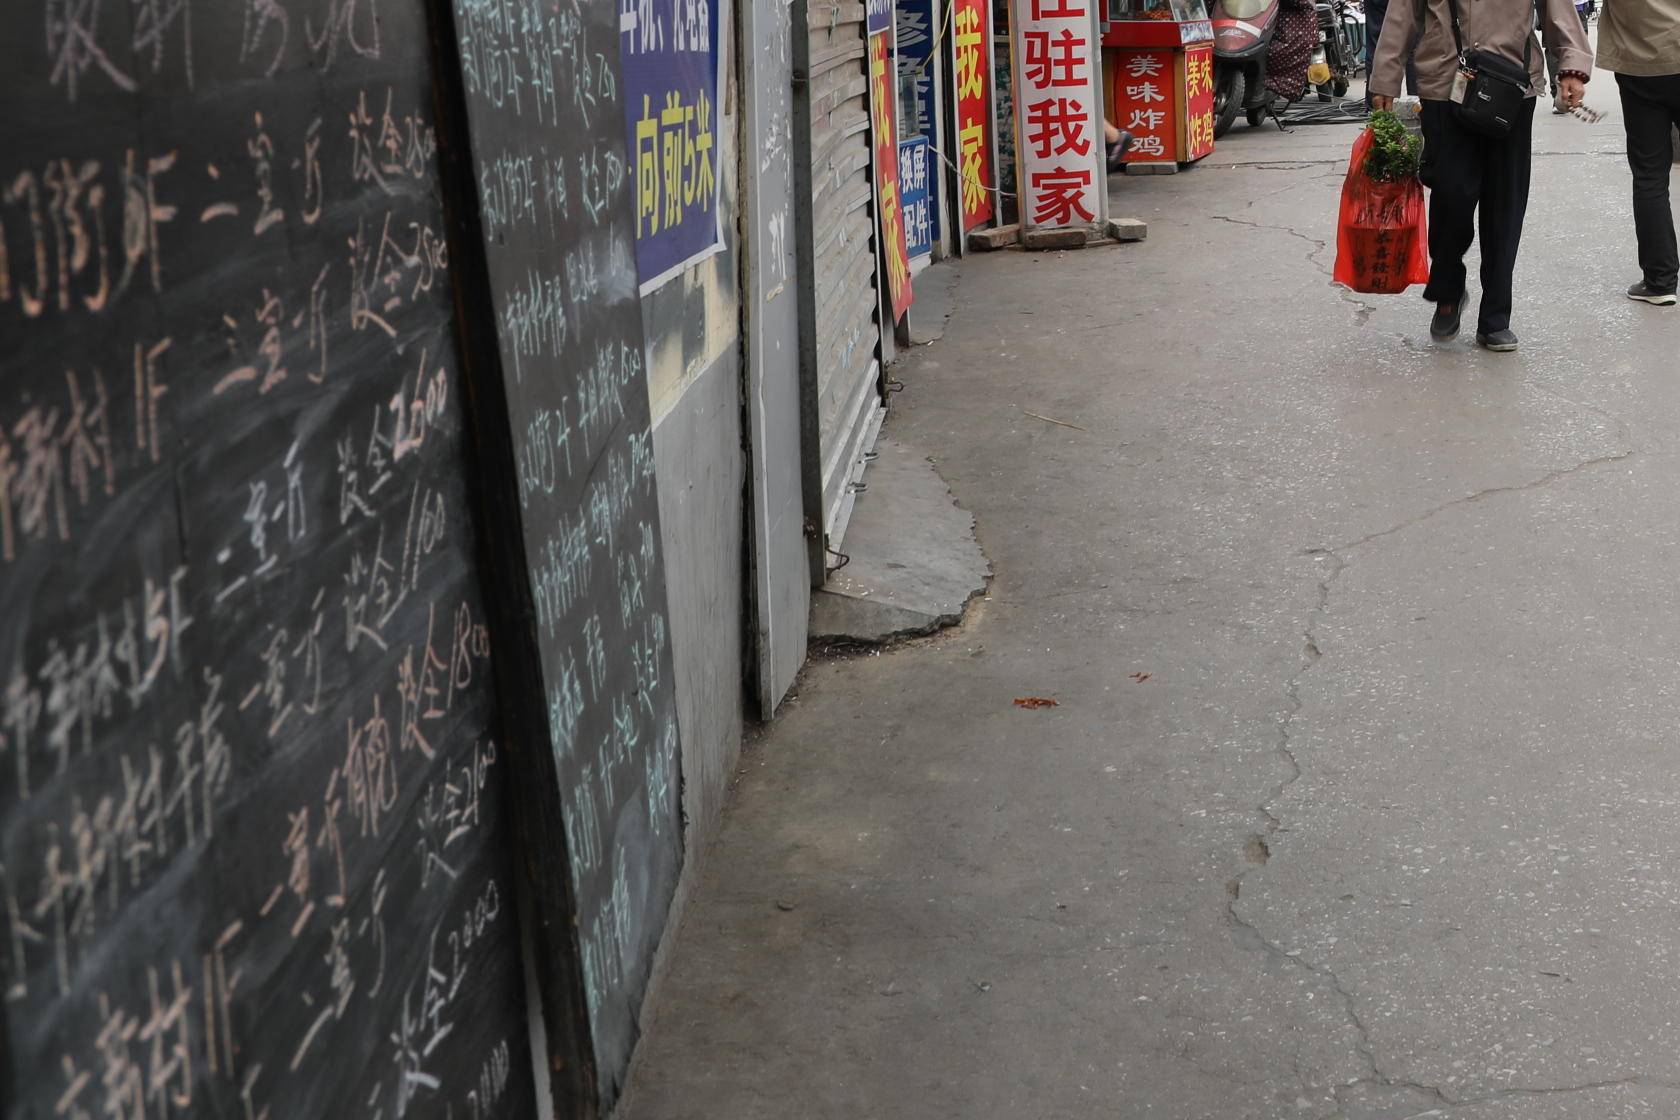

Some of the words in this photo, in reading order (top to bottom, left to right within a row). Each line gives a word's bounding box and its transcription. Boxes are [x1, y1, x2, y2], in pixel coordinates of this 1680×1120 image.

[1187, 53, 1213, 97] 美味
[1126, 54, 1166, 156] 美味炸鸡
[1189, 111, 1214, 155] 炸鸡
[637, 89, 714, 240] 向前5米
[900, 144, 925, 193] 换屏
[904, 200, 928, 249] 配件
